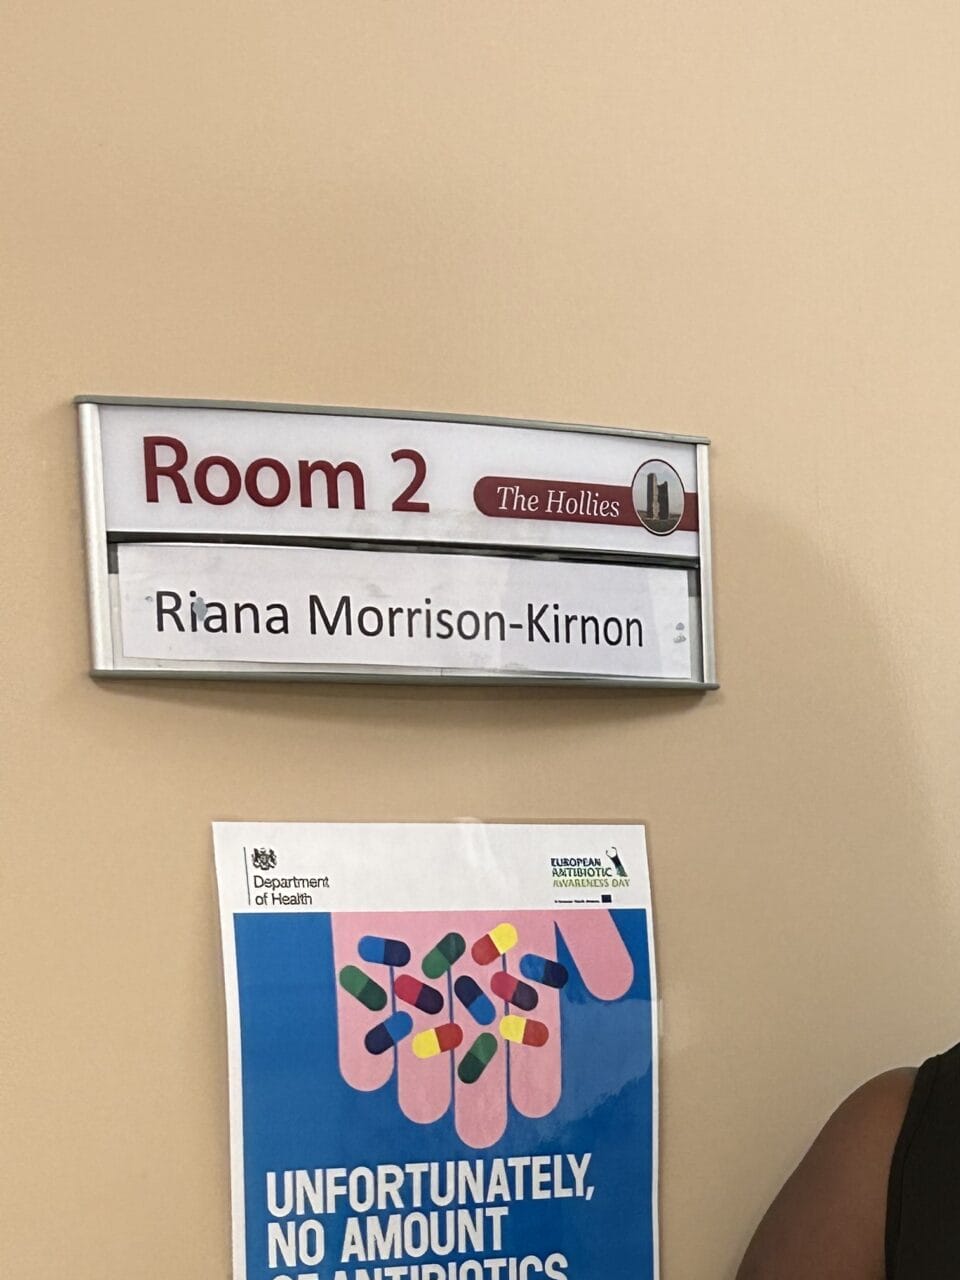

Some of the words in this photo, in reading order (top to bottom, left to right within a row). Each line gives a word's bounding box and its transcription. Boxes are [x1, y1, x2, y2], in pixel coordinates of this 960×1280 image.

[143, 436, 365, 510] Room
[391, 449, 430, 513] 2
[497, 484, 539, 513] The
[545, 489, 621, 519] Hollies
[155, 590, 290, 636] Riana
[308, 594, 645, 648] Morrison-Kirnon
[550, 857, 602, 867] EUROPEAN
[552, 867, 613, 878] ANTIBIOTIC
[253, 875, 330, 891] Department
[553, 878, 610, 888] AWARENESS
[611, 878, 631, 888] DAY
[255, 892, 268, 906] of
[271, 892, 313, 906] Health
[266, 1153, 596, 1218] UNFORTUNATELY,
[267, 1219, 326, 1268] NO
[341, 1206, 509, 1264] AMOUNT
